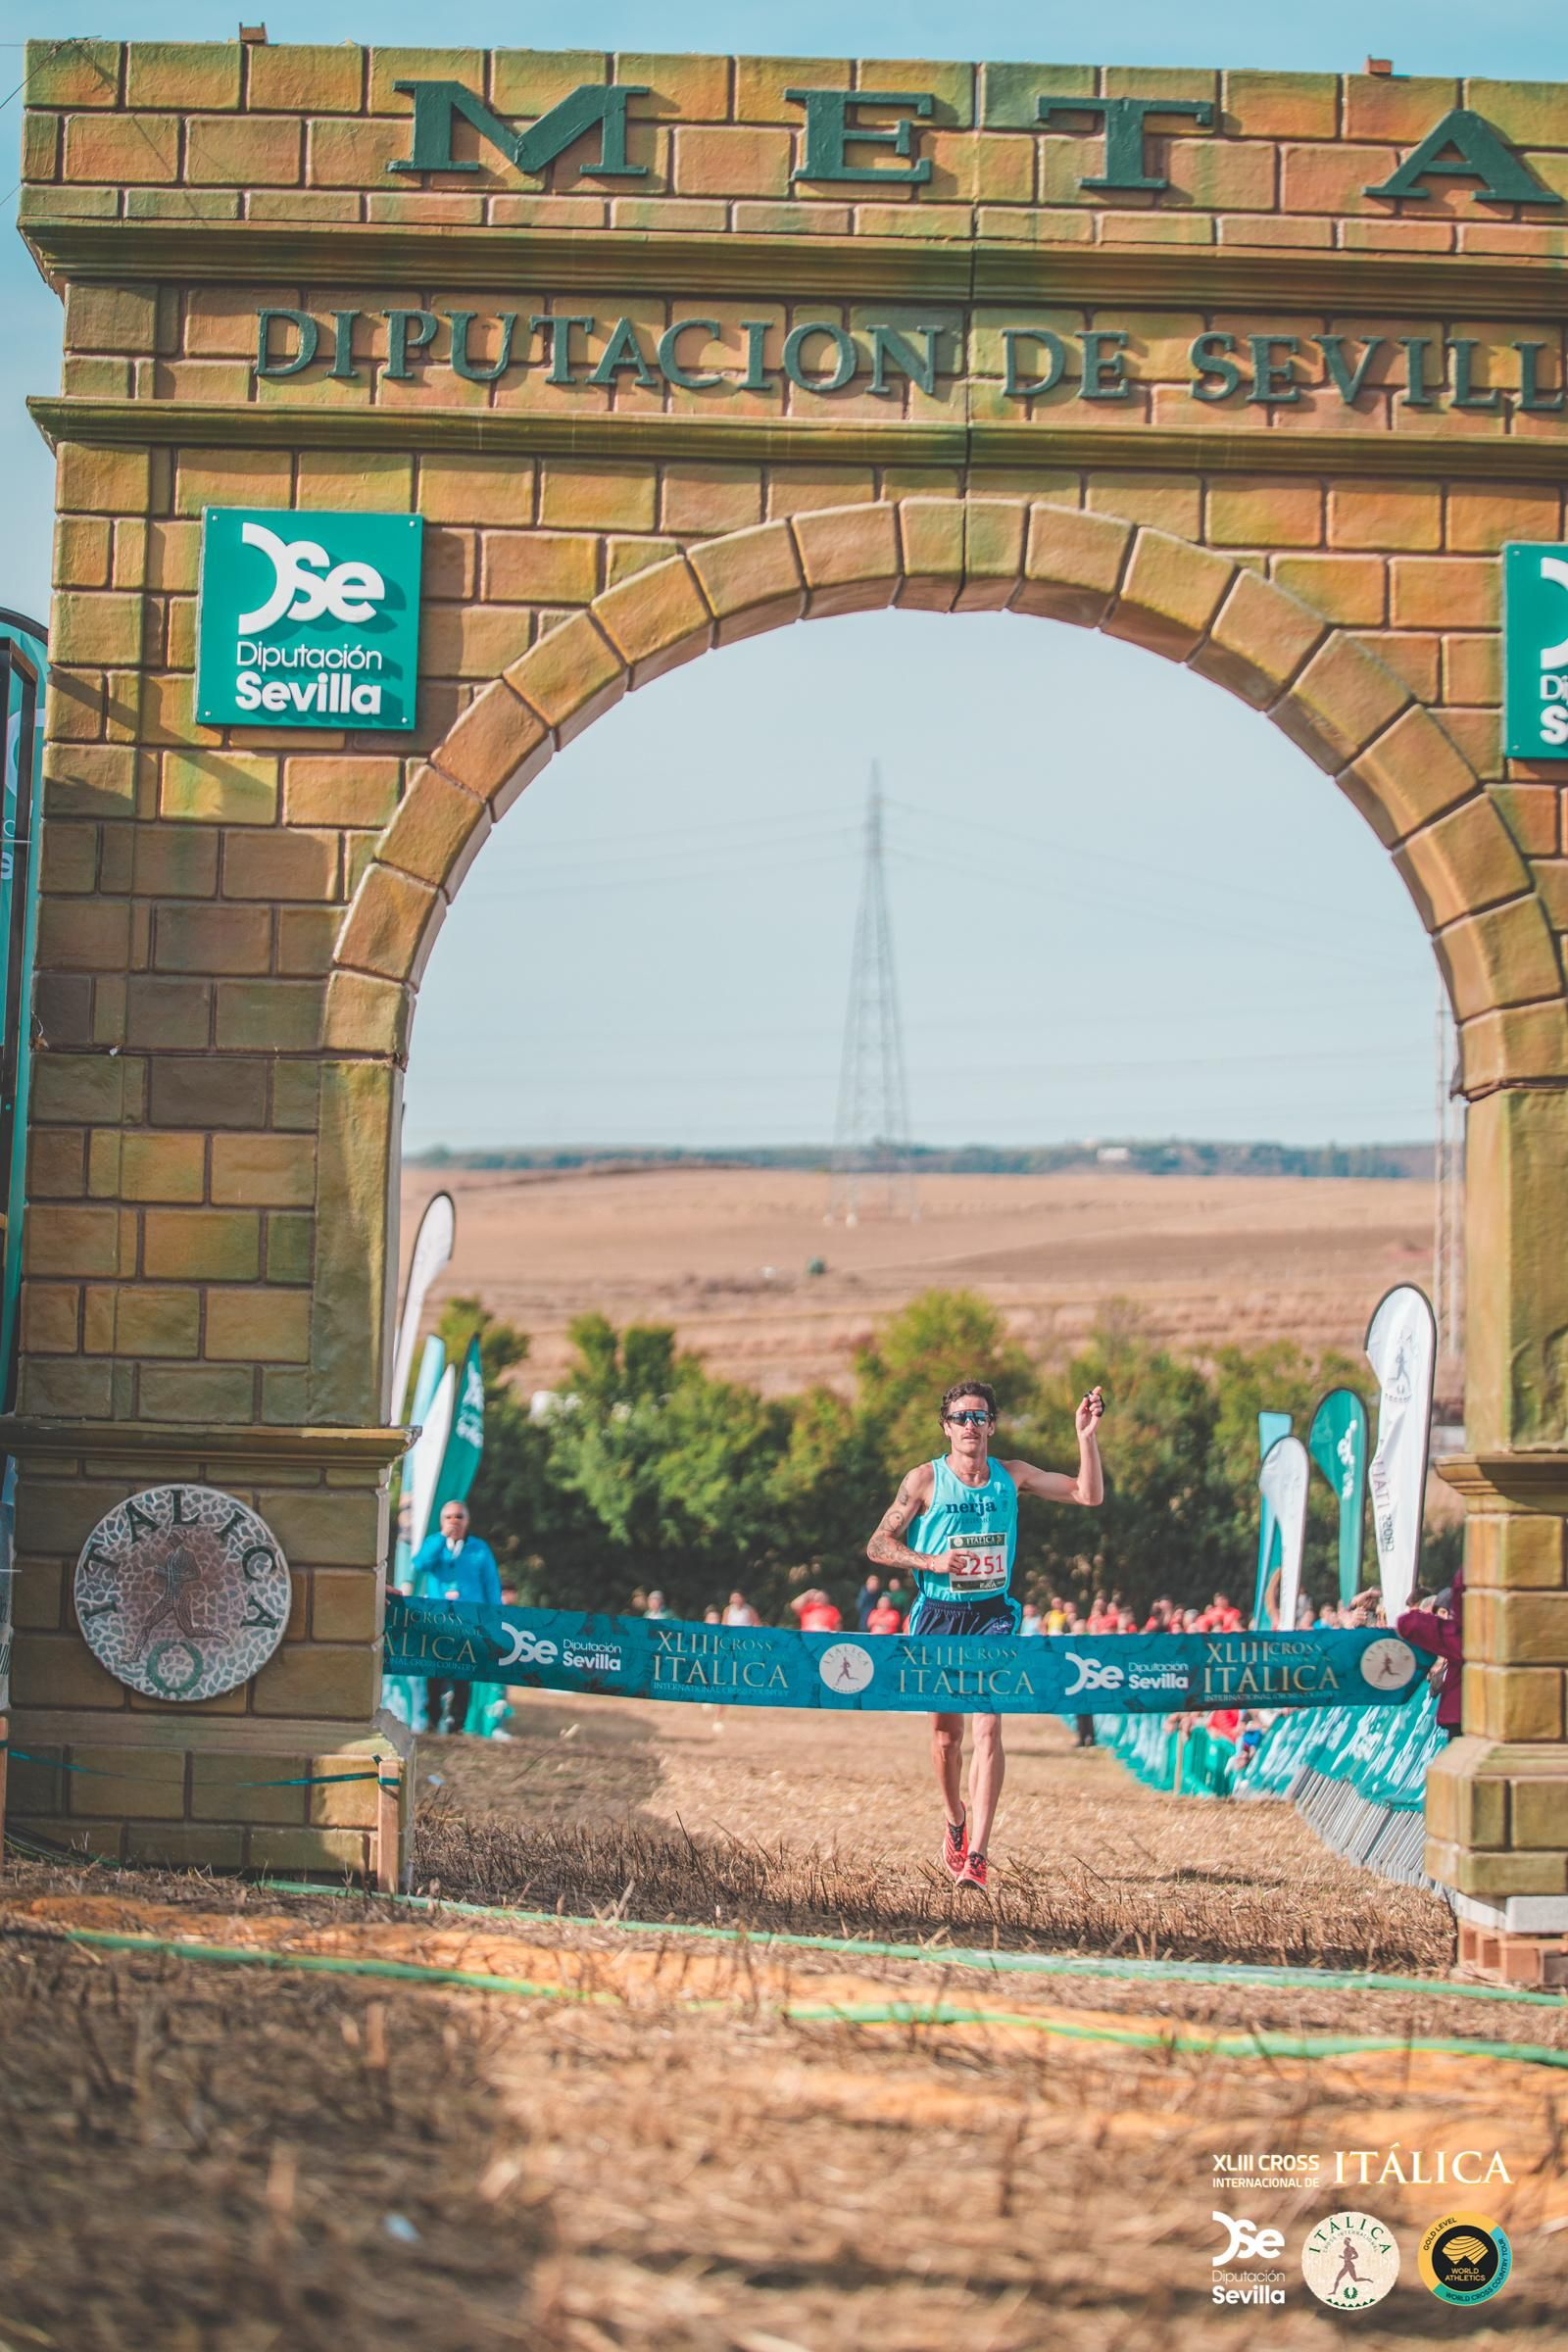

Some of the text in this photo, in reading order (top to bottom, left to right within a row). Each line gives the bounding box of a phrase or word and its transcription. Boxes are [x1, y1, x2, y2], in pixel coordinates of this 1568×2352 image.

[387, 79, 1563, 205] META
[254, 308, 1565, 412] DIPUTACION DE SEVILL
[236, 641, 382, 673] Diputación
[235, 670, 381, 715] Sevilla
[946, 1498, 998, 1516] nerja
[81, 1490, 278, 1631] ITALICA
[384, 1625, 477, 1664] ÁLICA
[564, 1638, 621, 1656] Diputación
[658, 1631, 718, 1655] XLIII
[1206, 1642, 1269, 1664] XLIII
[563, 1650, 621, 1671] Sevilla
[903, 1646, 963, 1666] XLIII
[1128, 1674, 1190, 1690] Sevilla
